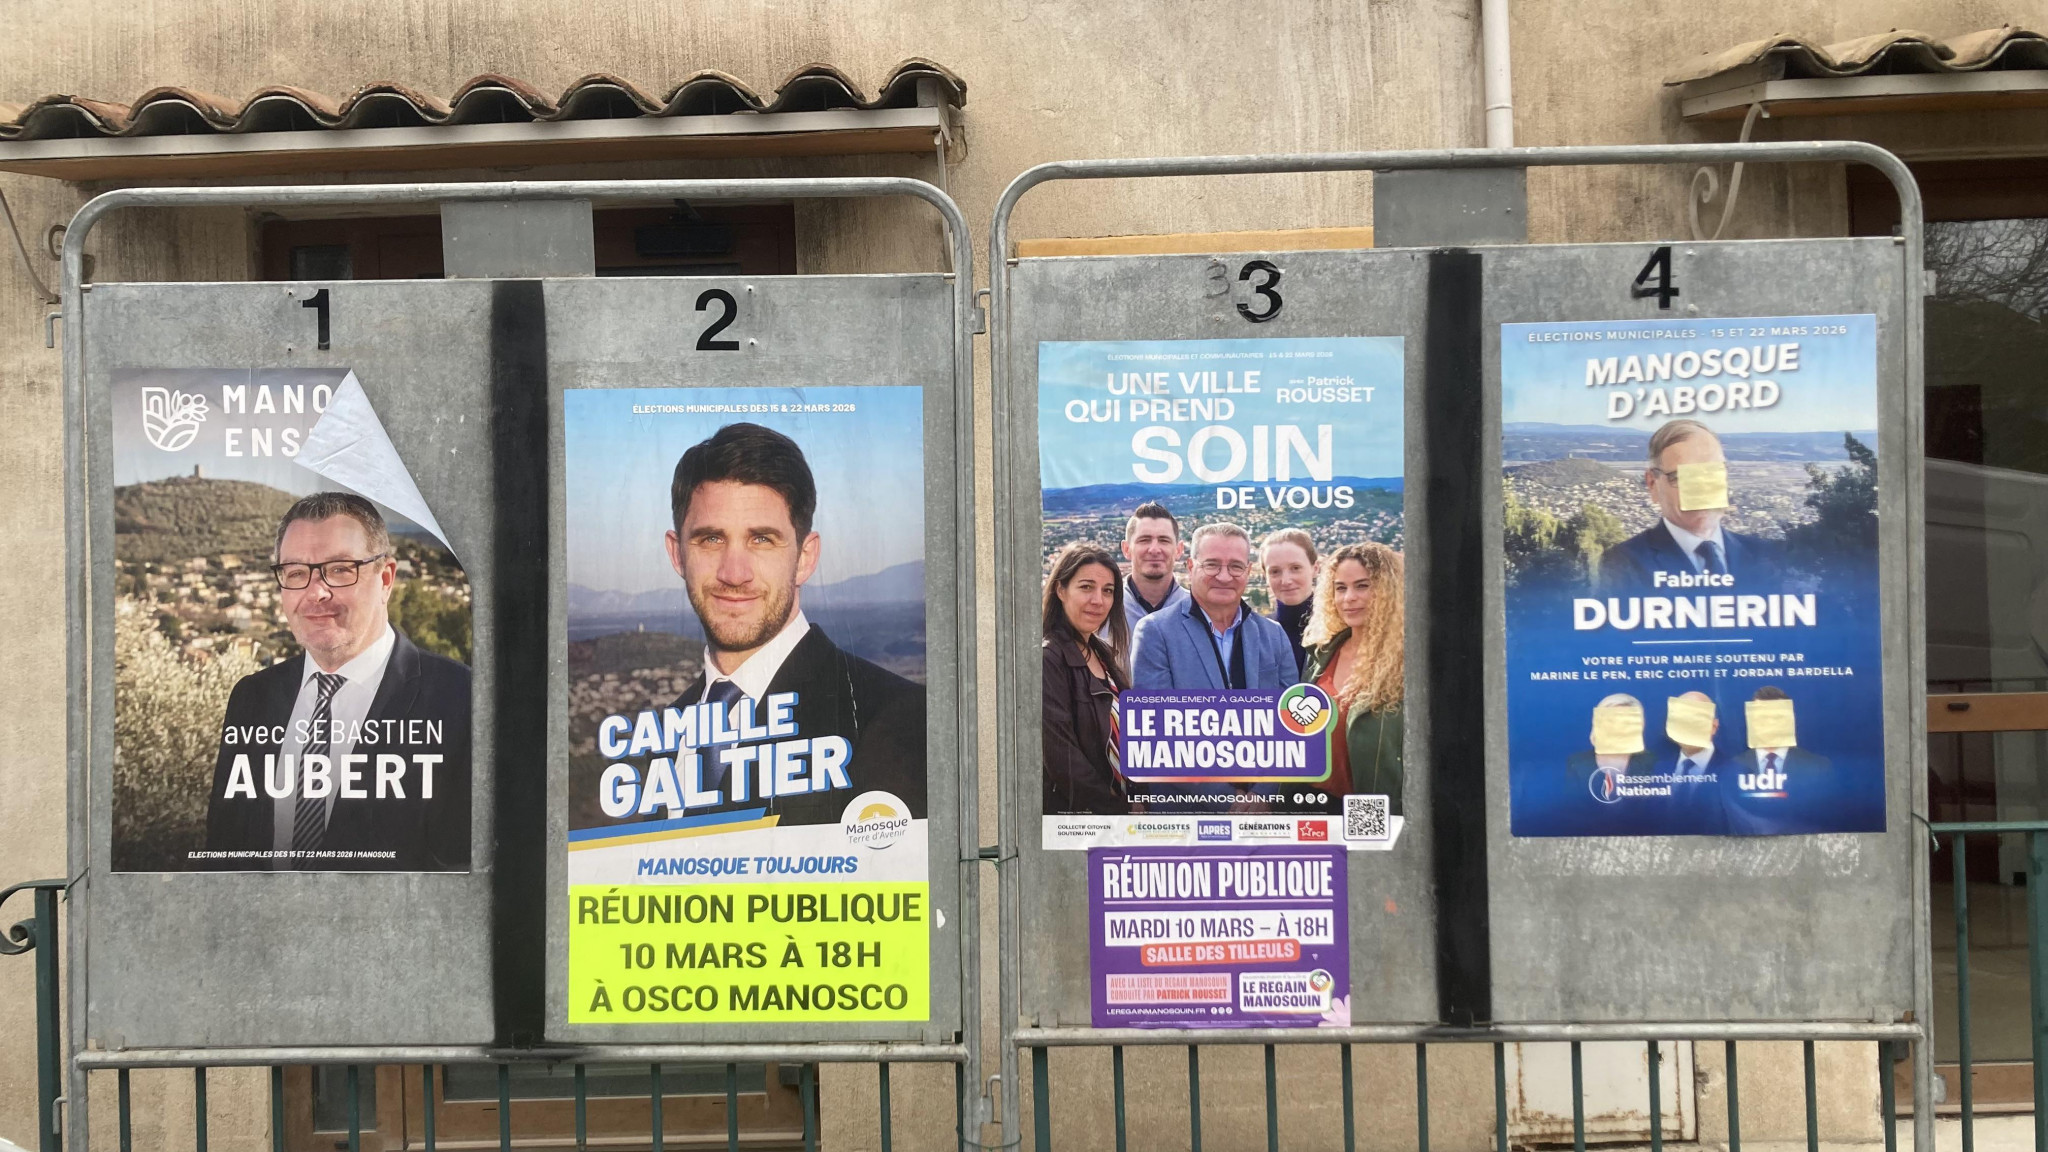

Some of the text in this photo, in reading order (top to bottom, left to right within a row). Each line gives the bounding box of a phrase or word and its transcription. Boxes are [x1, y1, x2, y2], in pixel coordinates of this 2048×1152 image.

[1631, 247, 1679, 310] 4
[1237, 260, 1282, 323] 3
[302, 288, 330, 350] 1
[695, 289, 739, 350] 2
[1528, 331, 1602, 342] ÉLECTIONS
[1607, 329, 1696, 341] MUNICIPALES
[1710, 329, 1724, 337] 15
[1730, 328, 1744, 337] ET
[1749, 328, 1765, 337] 22
[1771, 327, 1808, 336] MARS
[1813, 326, 1847, 335] 2026
[1585, 343, 1799, 386] MANOSQUE
[1107, 371, 1261, 395] UNE VILLE
[1306, 375, 1355, 386] Patrick
[222, 384, 333, 414] MANO
[1276, 387, 1375, 403] ROUSSET
[1608, 380, 1780, 419] D'ABORD
[633, 404, 684, 413] ÉLECTIONS
[790, 404, 802, 412] 22
[804, 404, 830, 412] MARS
[832, 404, 855, 412] 2026
[1064, 398, 1235, 423] QUI PREND
[1131, 424, 1333, 483] SOIN
[1217, 486, 1354, 510] DE VOUS
[1654, 570, 1734, 588] Fabrice
[1573, 594, 1816, 630] DURNERIN
[1582, 653, 1804, 666] VOTRE FUTUR MAIRE SOUTENU PAR
[1531, 671, 1579, 681] MARINE
[1583, 671, 1598, 679] LE
[1635, 670, 1664, 679] ERIC
[1668, 669, 1709, 678] CIOTTI
[1714, 669, 1727, 678] ET
[1732, 668, 1783, 678] JORDAN
[1787, 666, 1853, 677] BARDELLA
[1219, 693, 1227, 703] À
[1229, 695, 1273, 703] GAUCHE
[225, 714, 443, 744] avec SÉBASTIEN
[599, 691, 799, 759] CAMILLE
[1127, 709, 1273, 737] LE REGAIN
[1127, 740, 1306, 768] MANOSQUIN
[224, 753, 444, 799] AUBERT
[599, 735, 853, 818] GALTIER
[1616, 773, 1717, 784] Rassemblement
[1738, 769, 1787, 790] udr
[1127, 794, 1285, 803] LEREGAINMANOSQUIN.FR
[1616, 785, 1670, 796] National
[846, 818, 908, 835] Manosque
[849, 829, 906, 845] Terre d'Avenir
[638, 856, 858, 877] MANOSQUE TOUJOURS
[1103, 855, 1333, 899] RÉUNION PUBLIQUE
[578, 888, 921, 925] RÉUNION PUBLIQUE
[1110, 919, 1170, 939] MARDI
[1175, 919, 1194, 938] 10
[1201, 918, 1254, 937] MARS
[1277, 913, 1289, 936] À
[1294, 917, 1328, 936] 18H
[619, 935, 881, 969] 10 MARS À 18H
[1147, 942, 1294, 964] SALLE DES TILLEULS
[1111, 978, 1126, 988] AVEC
[1128, 978, 1135, 988] LA
[1138, 978, 1153, 987] LISTE
[1165, 977, 1187, 987] REGAIN
[1190, 977, 1227, 987] MANOSQUIN
[1143, 990, 1154, 999] PAR
[1157, 989, 1190, 999] PATRICK
[1193, 989, 1227, 999] ROUSSET
[1243, 981, 1306, 993] LE REGAIN
[589, 979, 908, 1012] À OSCO MANOSCO
[1244, 995, 1320, 1007] MANOSQUIN
